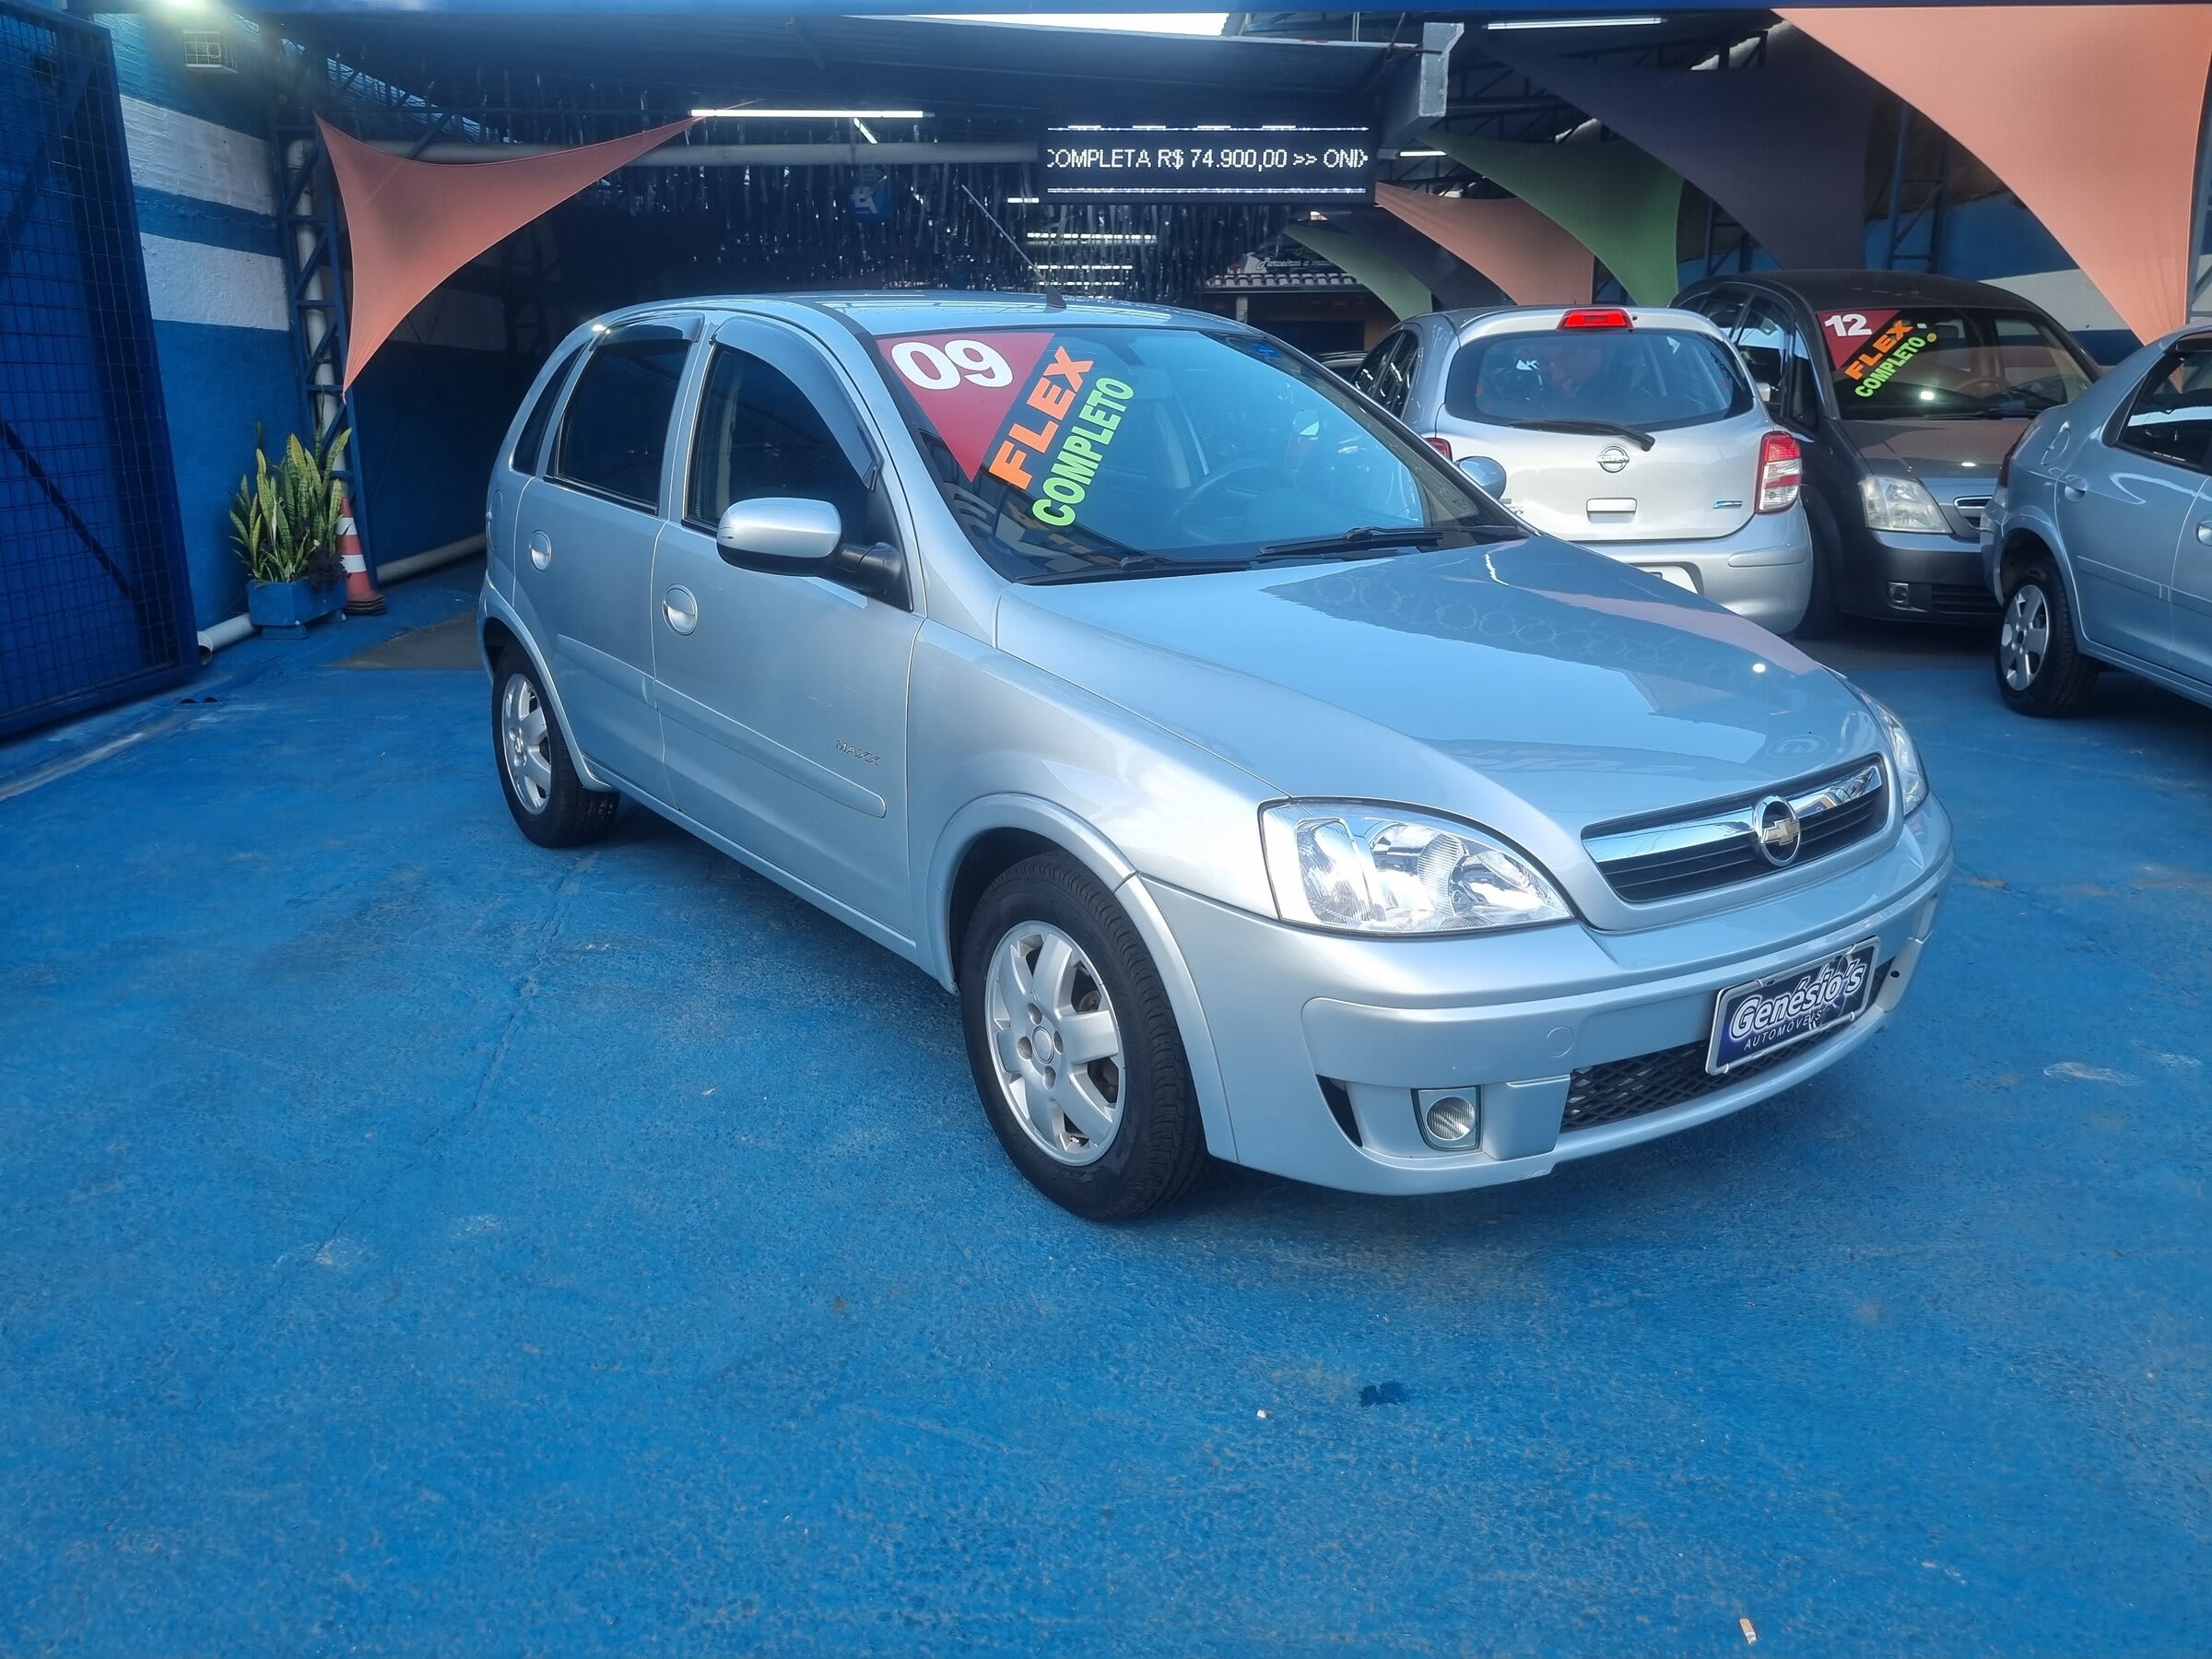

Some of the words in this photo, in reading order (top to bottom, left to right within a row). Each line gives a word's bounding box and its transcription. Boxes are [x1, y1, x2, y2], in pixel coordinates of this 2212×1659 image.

[1157, 148, 1184, 171] R$
[1190, 148, 1288, 172] 74.900,00
[1824, 313, 1873, 337] 12
[1844, 320, 1914, 381] FLEX
[890, 339, 1014, 390] 09
[1854, 336, 1926, 397] COMPLETO
[988, 346, 1095, 490] FLEX
[1031, 376, 1135, 527] COMPLETO
